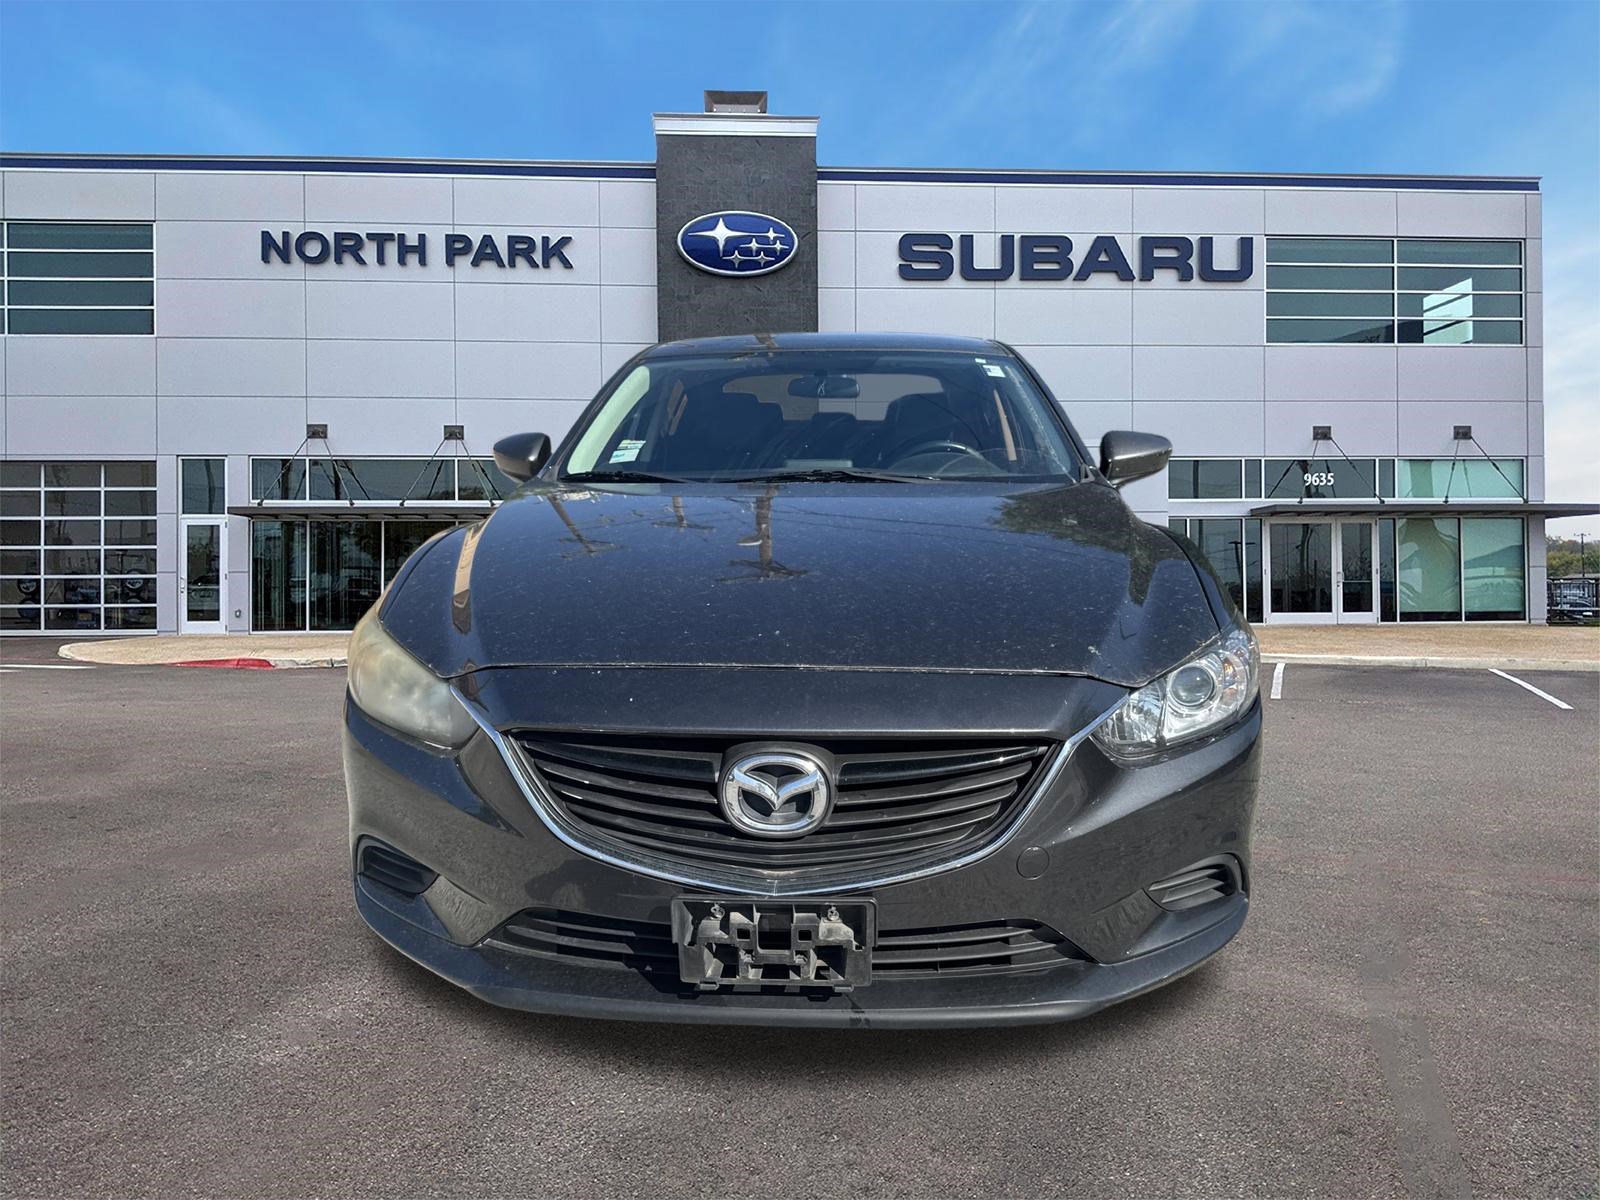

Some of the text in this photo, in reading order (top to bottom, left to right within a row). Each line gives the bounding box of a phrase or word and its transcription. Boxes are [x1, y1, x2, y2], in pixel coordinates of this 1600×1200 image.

[260, 230, 574, 269] NORTH PARK
[898, 233, 1254, 282] SUBARU
[1303, 472, 1335, 486] 9635
